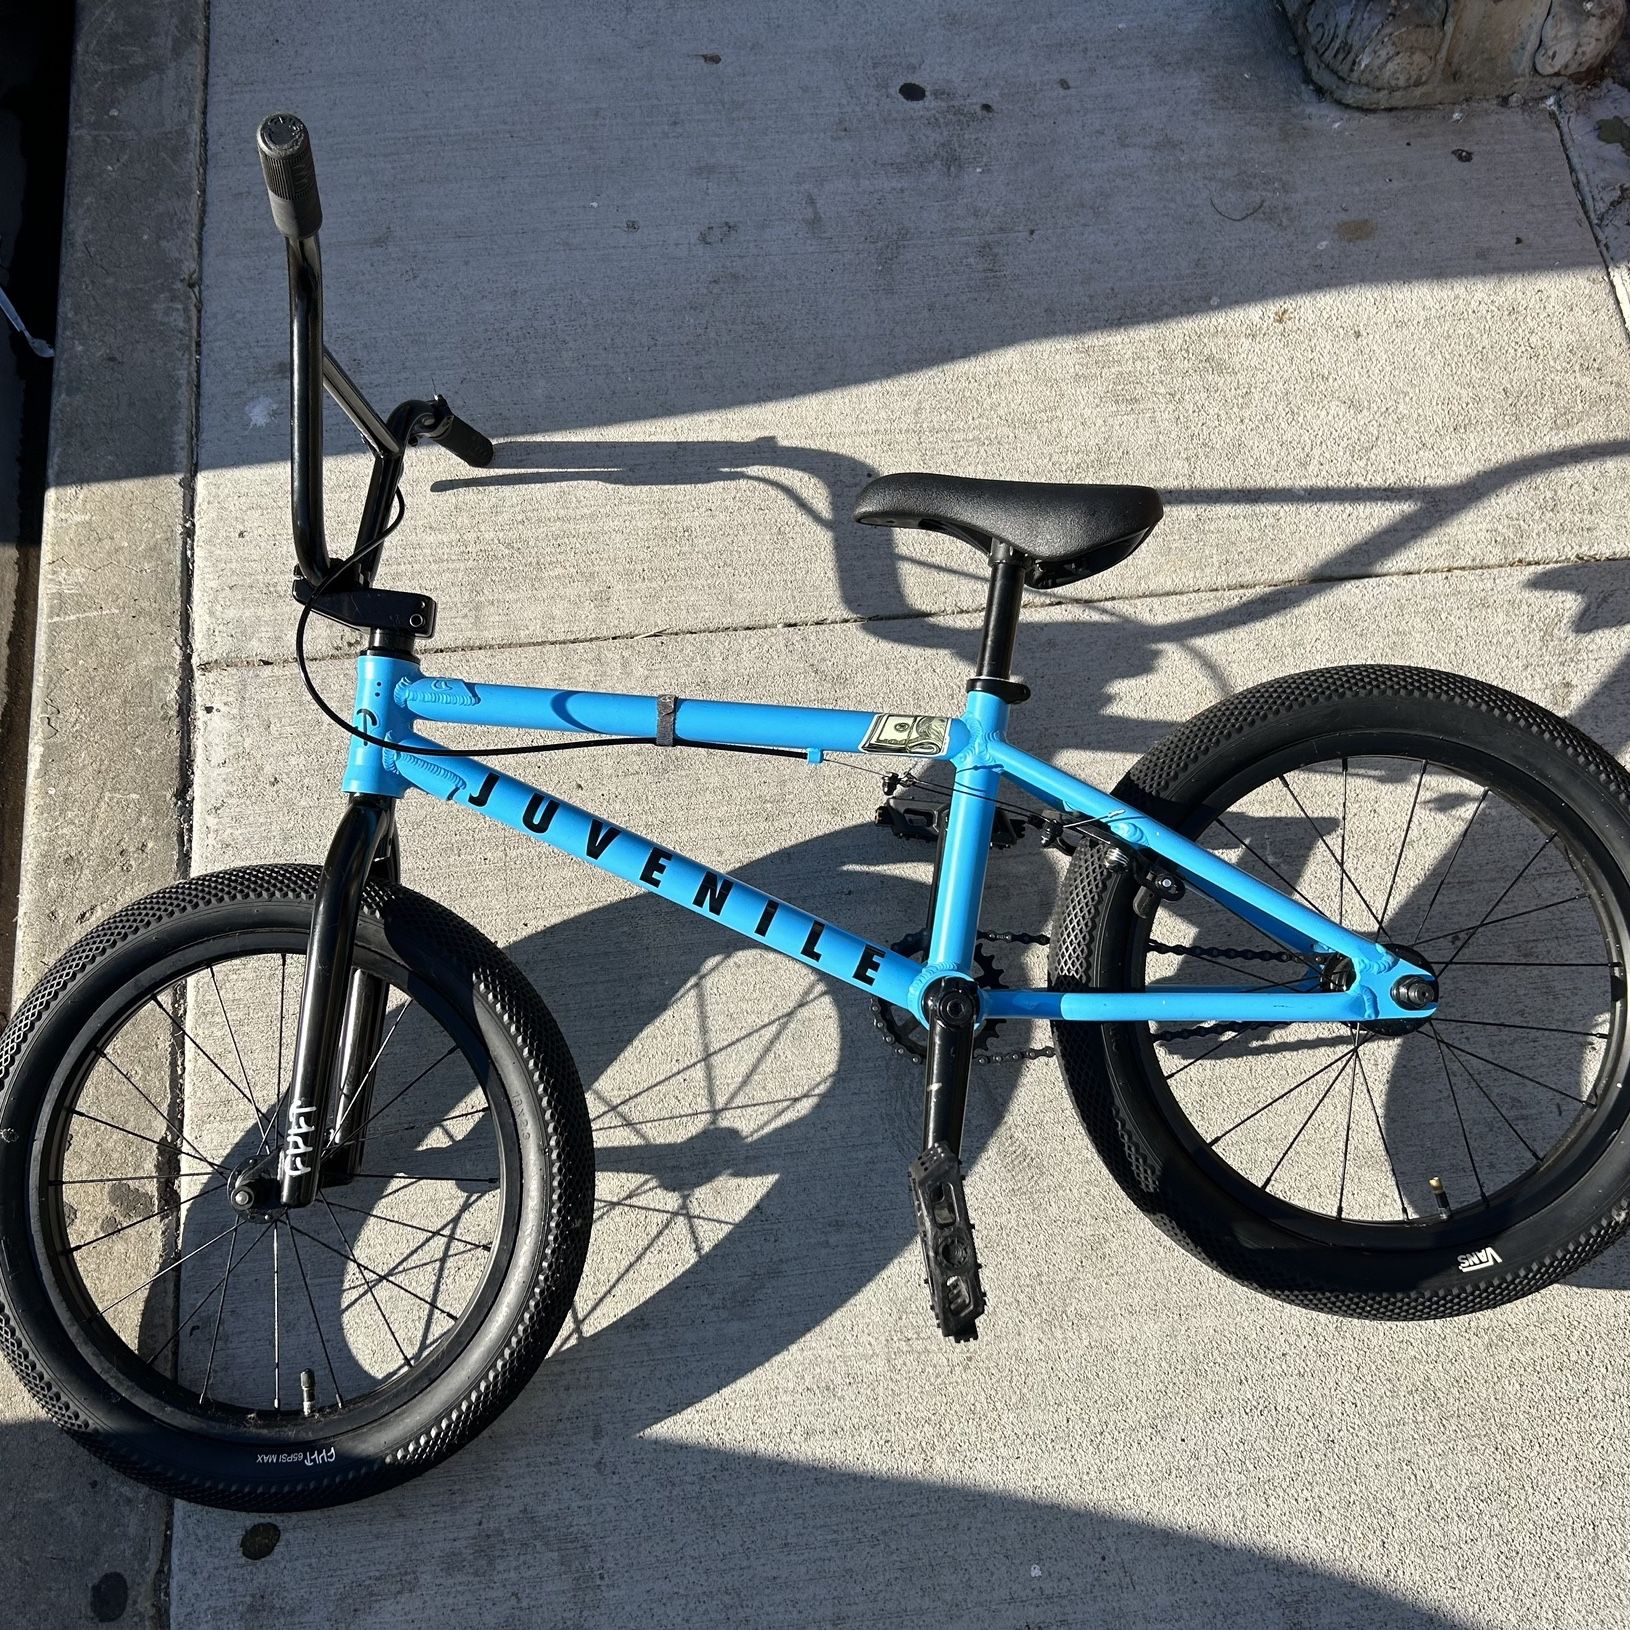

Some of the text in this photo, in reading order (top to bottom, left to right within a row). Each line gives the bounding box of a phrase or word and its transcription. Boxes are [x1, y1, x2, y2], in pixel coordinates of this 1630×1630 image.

[468, 771, 886, 987] JUVENILE
[284, 1099, 317, 1177] CULT
[1457, 1246, 1503, 1273] VANS
[256, 1446, 336, 1466] CULT 65PSI MAX
